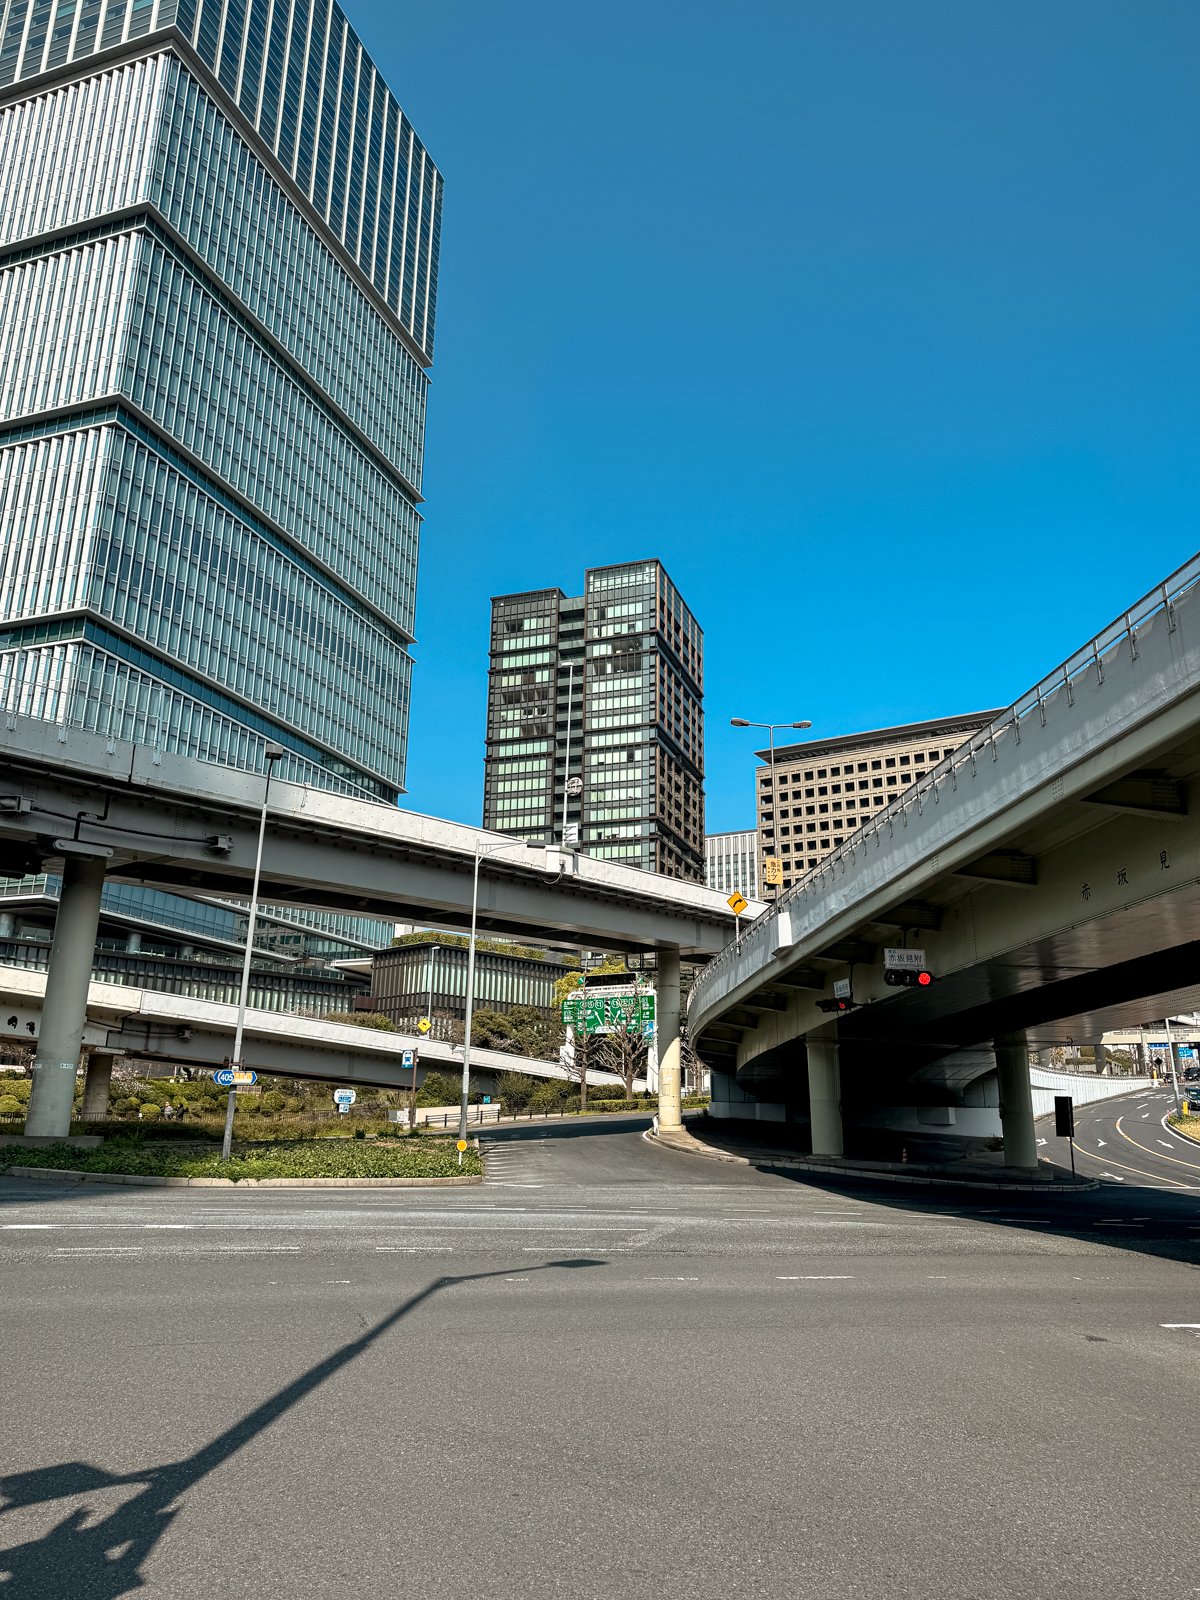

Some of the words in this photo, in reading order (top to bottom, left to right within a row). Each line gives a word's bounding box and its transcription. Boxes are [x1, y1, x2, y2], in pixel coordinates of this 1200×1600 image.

[888, 953, 922, 963] 赤坂見附
[220, 1073, 234, 1082] 405
